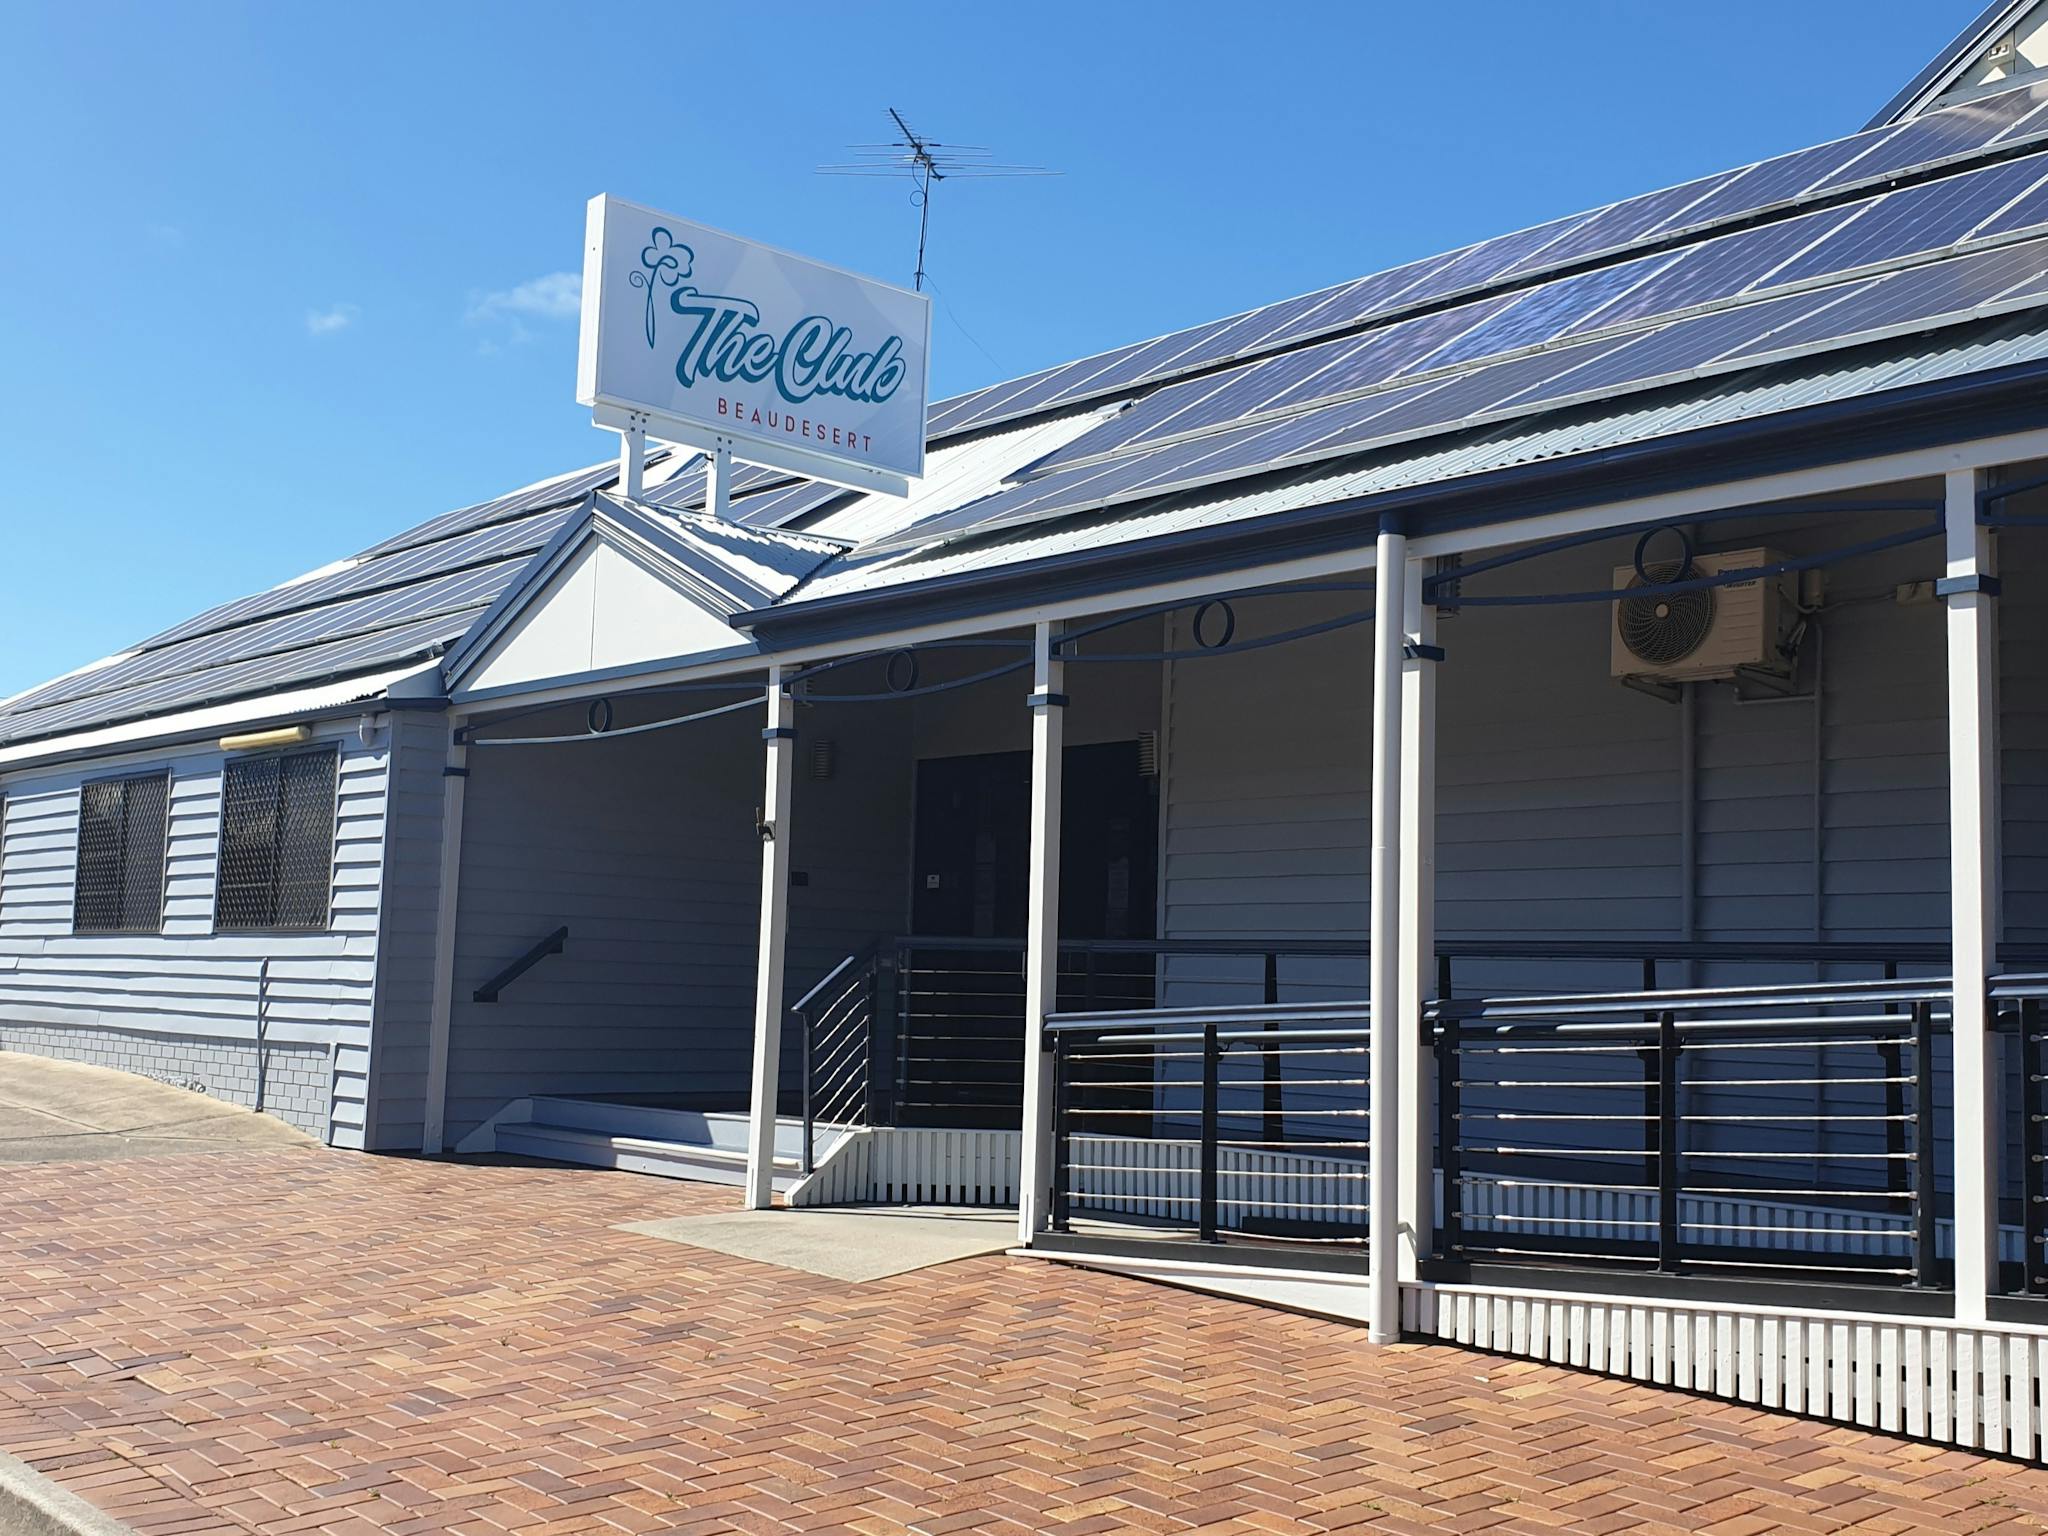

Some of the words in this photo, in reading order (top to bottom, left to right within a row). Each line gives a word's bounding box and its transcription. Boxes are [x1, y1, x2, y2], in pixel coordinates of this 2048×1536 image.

[670, 287, 777, 388] The
[775, 316, 906, 404] Club
[718, 398, 871, 452] BEAUDESERT
